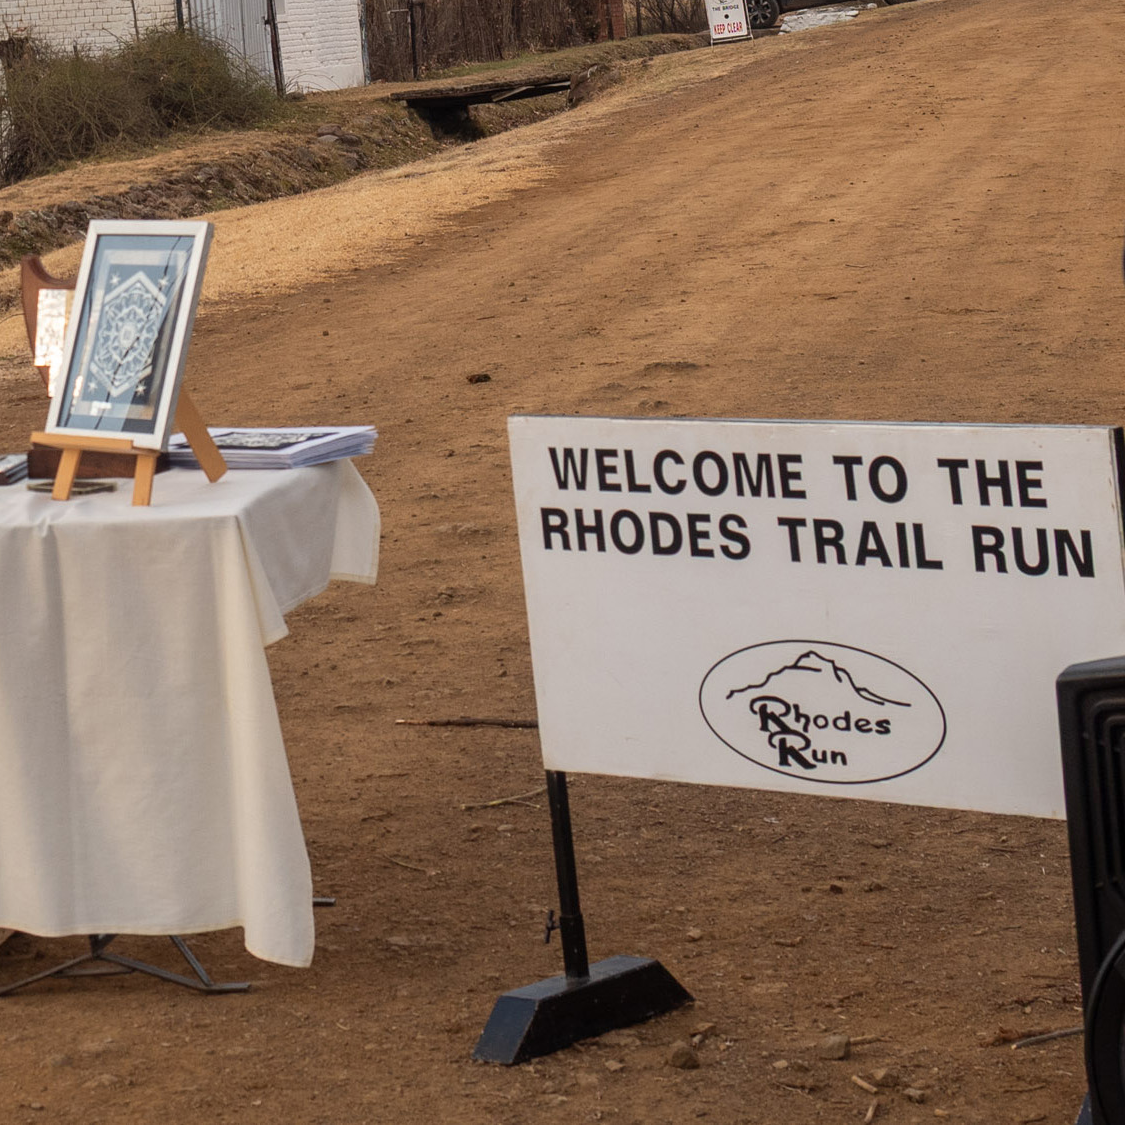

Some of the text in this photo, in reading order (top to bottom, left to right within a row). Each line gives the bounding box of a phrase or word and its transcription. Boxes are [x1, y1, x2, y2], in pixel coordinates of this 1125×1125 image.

[714, 21, 742, 34] KEEP CLEAR
[548, 446, 1048, 509] WELCOME TO THE
[540, 507, 1096, 579] RHODES TRAIL RUN
[750, 695, 892, 737] Rhodes
[769, 730, 848, 770] Run
